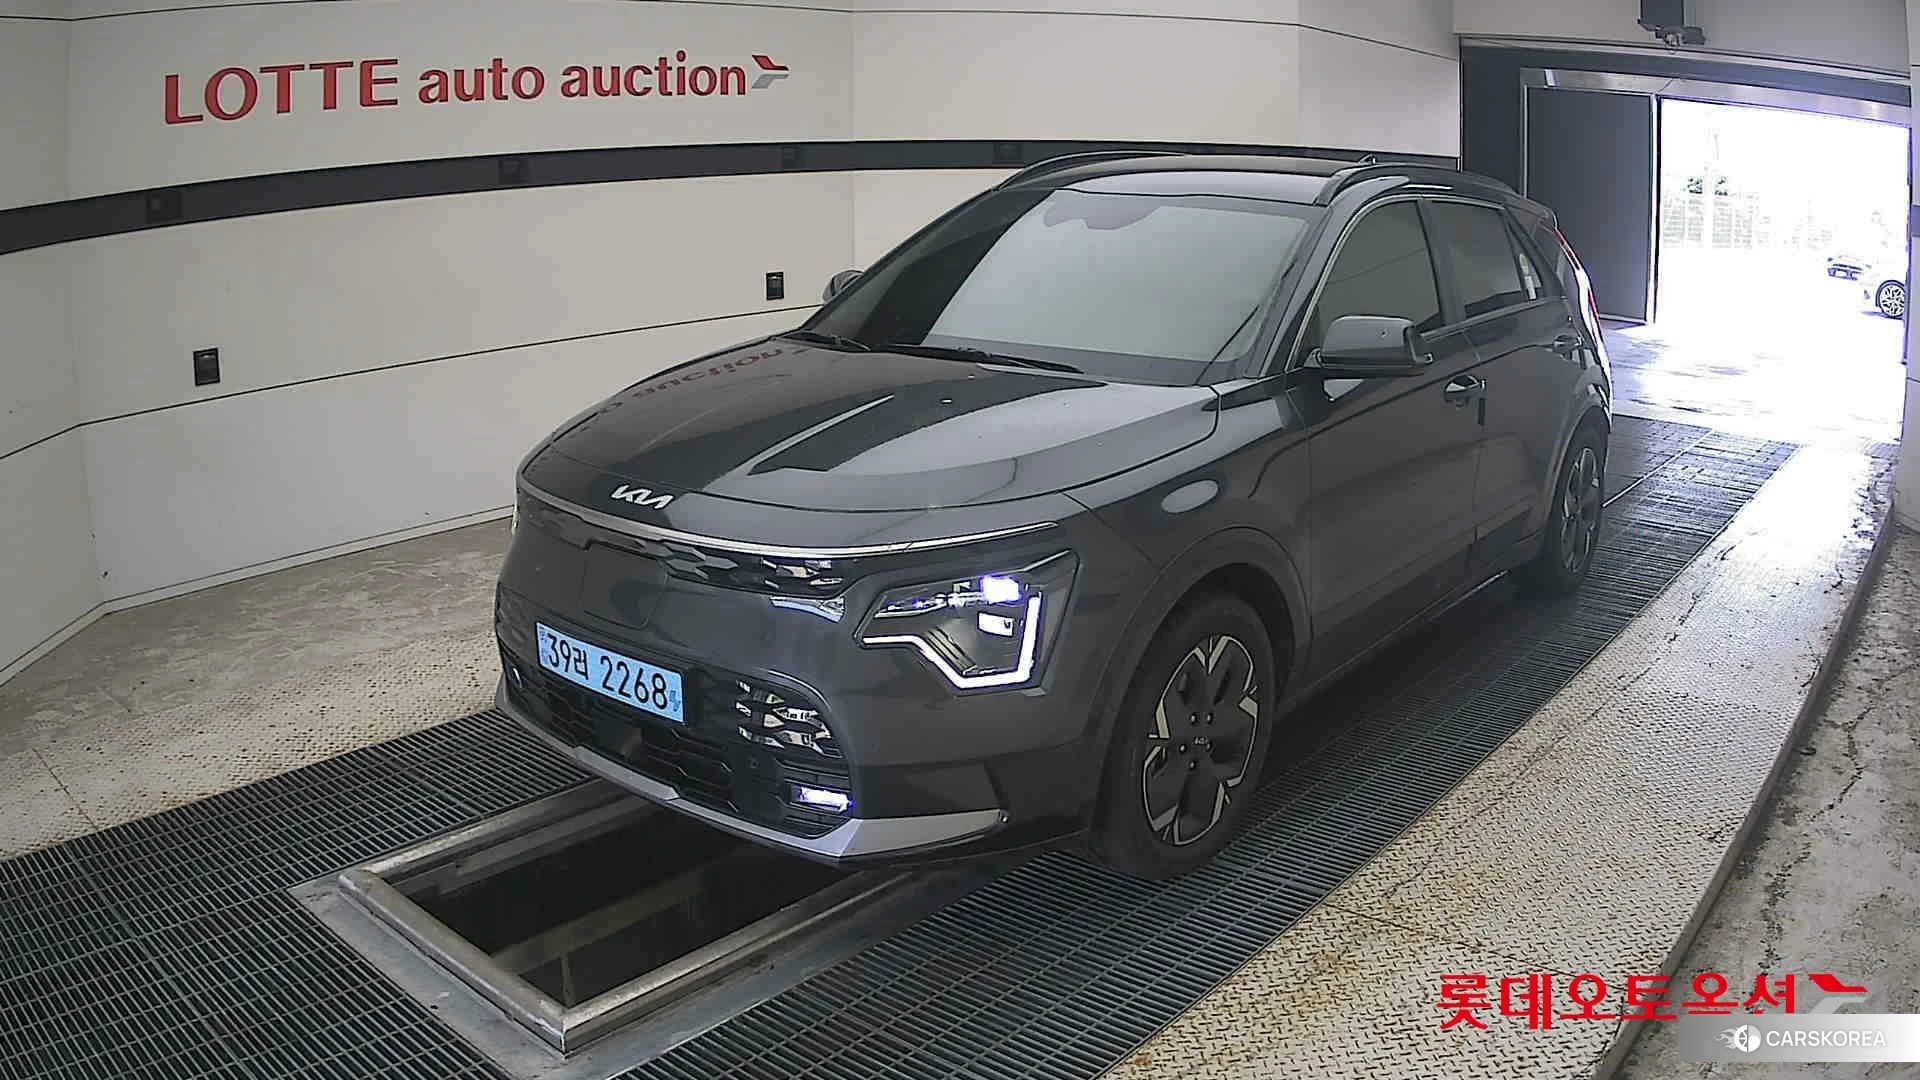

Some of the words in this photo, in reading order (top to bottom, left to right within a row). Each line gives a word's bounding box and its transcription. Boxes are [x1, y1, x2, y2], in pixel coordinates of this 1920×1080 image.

[164, 58, 398, 125] LOTTE
[418, 58, 545, 104] auto
[561, 51, 747, 98] auction
[600, 655, 668, 710] 2268
